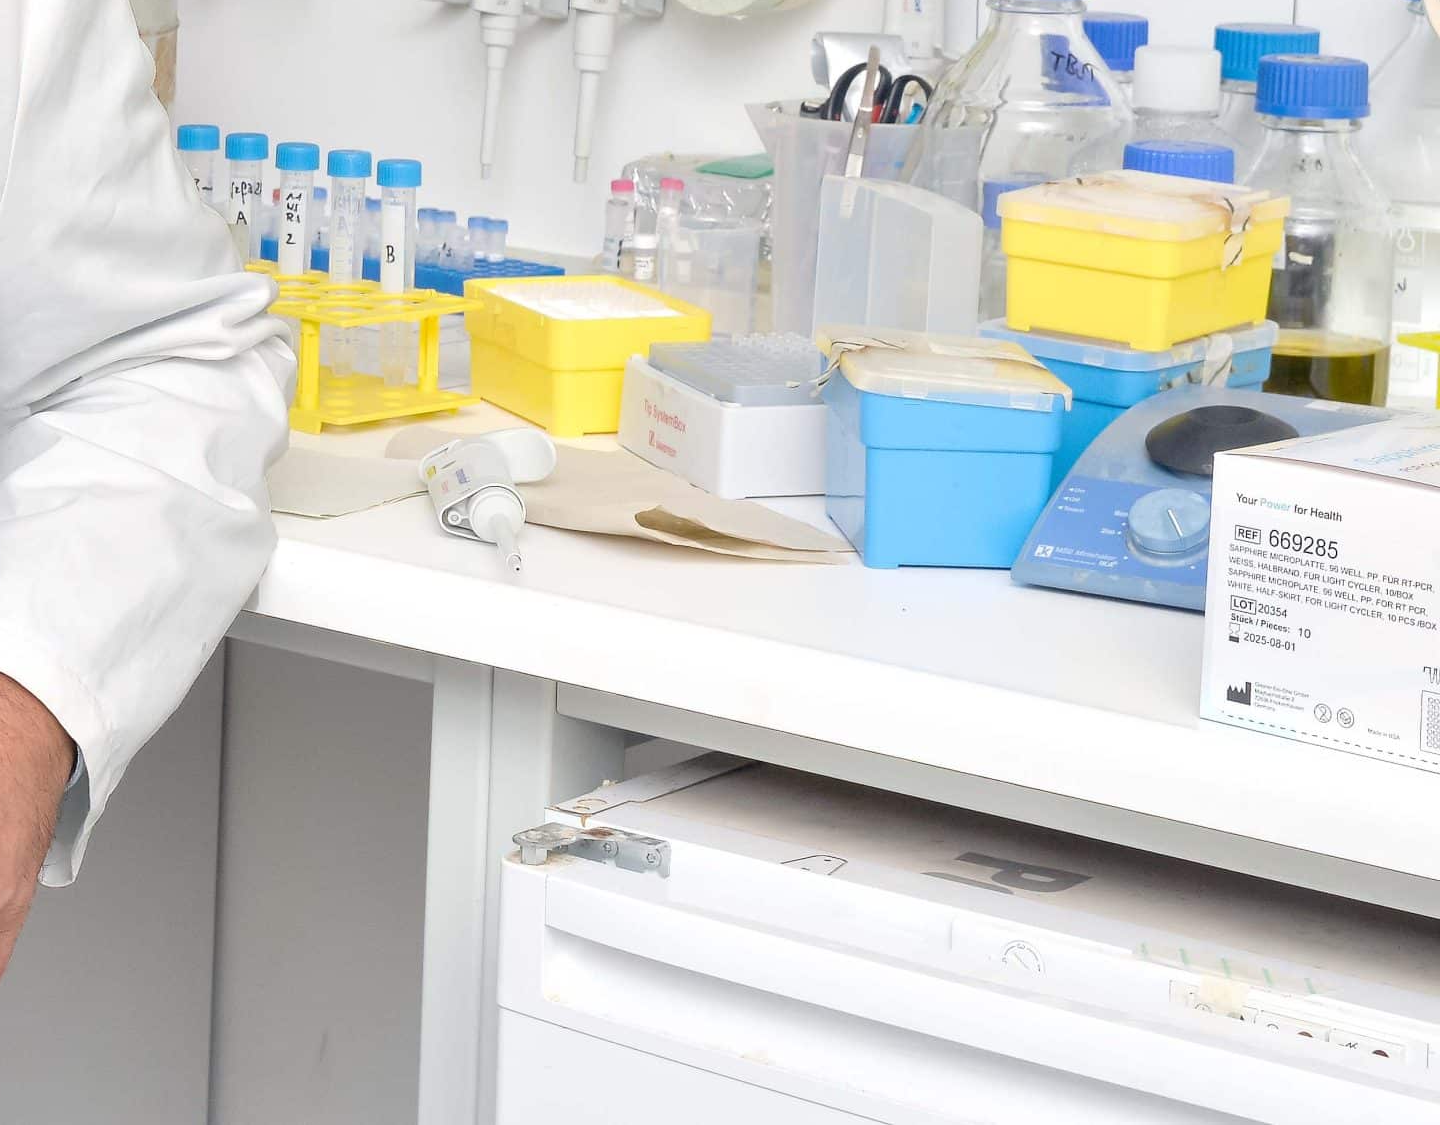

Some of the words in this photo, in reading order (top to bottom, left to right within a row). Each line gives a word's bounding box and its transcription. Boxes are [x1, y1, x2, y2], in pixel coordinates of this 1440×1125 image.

[236, 211, 248, 225] A
[386, 245, 396, 263] B
[1236, 492, 1258, 506] Your
[1260, 498, 1291, 511] Power
[1294, 504, 1308, 515] for
[1310, 507, 1342, 522] Health
[1238, 528, 1258, 540] REF
[1269, 529, 1338, 559] 669285
[1229, 544, 1268, 559] SAPPHIRE
[1227, 567, 1267, 584] SAPPHIRE
[1375, 598, 1393, 610] FOR
[1395, 602, 1407, 611] RT
[1322, 575, 1346, 587] LIGHT
[1385, 588, 1414, 601] 10/BOX
[1233, 598, 1254, 611] LOT
[1257, 603, 1288, 619] 20354
[1305, 596, 1323, 607] FOR
[1324, 601, 1348, 612] LIGHT
[1388, 614, 1397, 622] 10
[1398, 616, 1416, 627] PCS
[1231, 613, 1254, 625] Stück
[1260, 619, 1291, 634] Pieces:
[1298, 627, 1312, 639] 10
[1243, 631, 1296, 652] 2025-08-01
